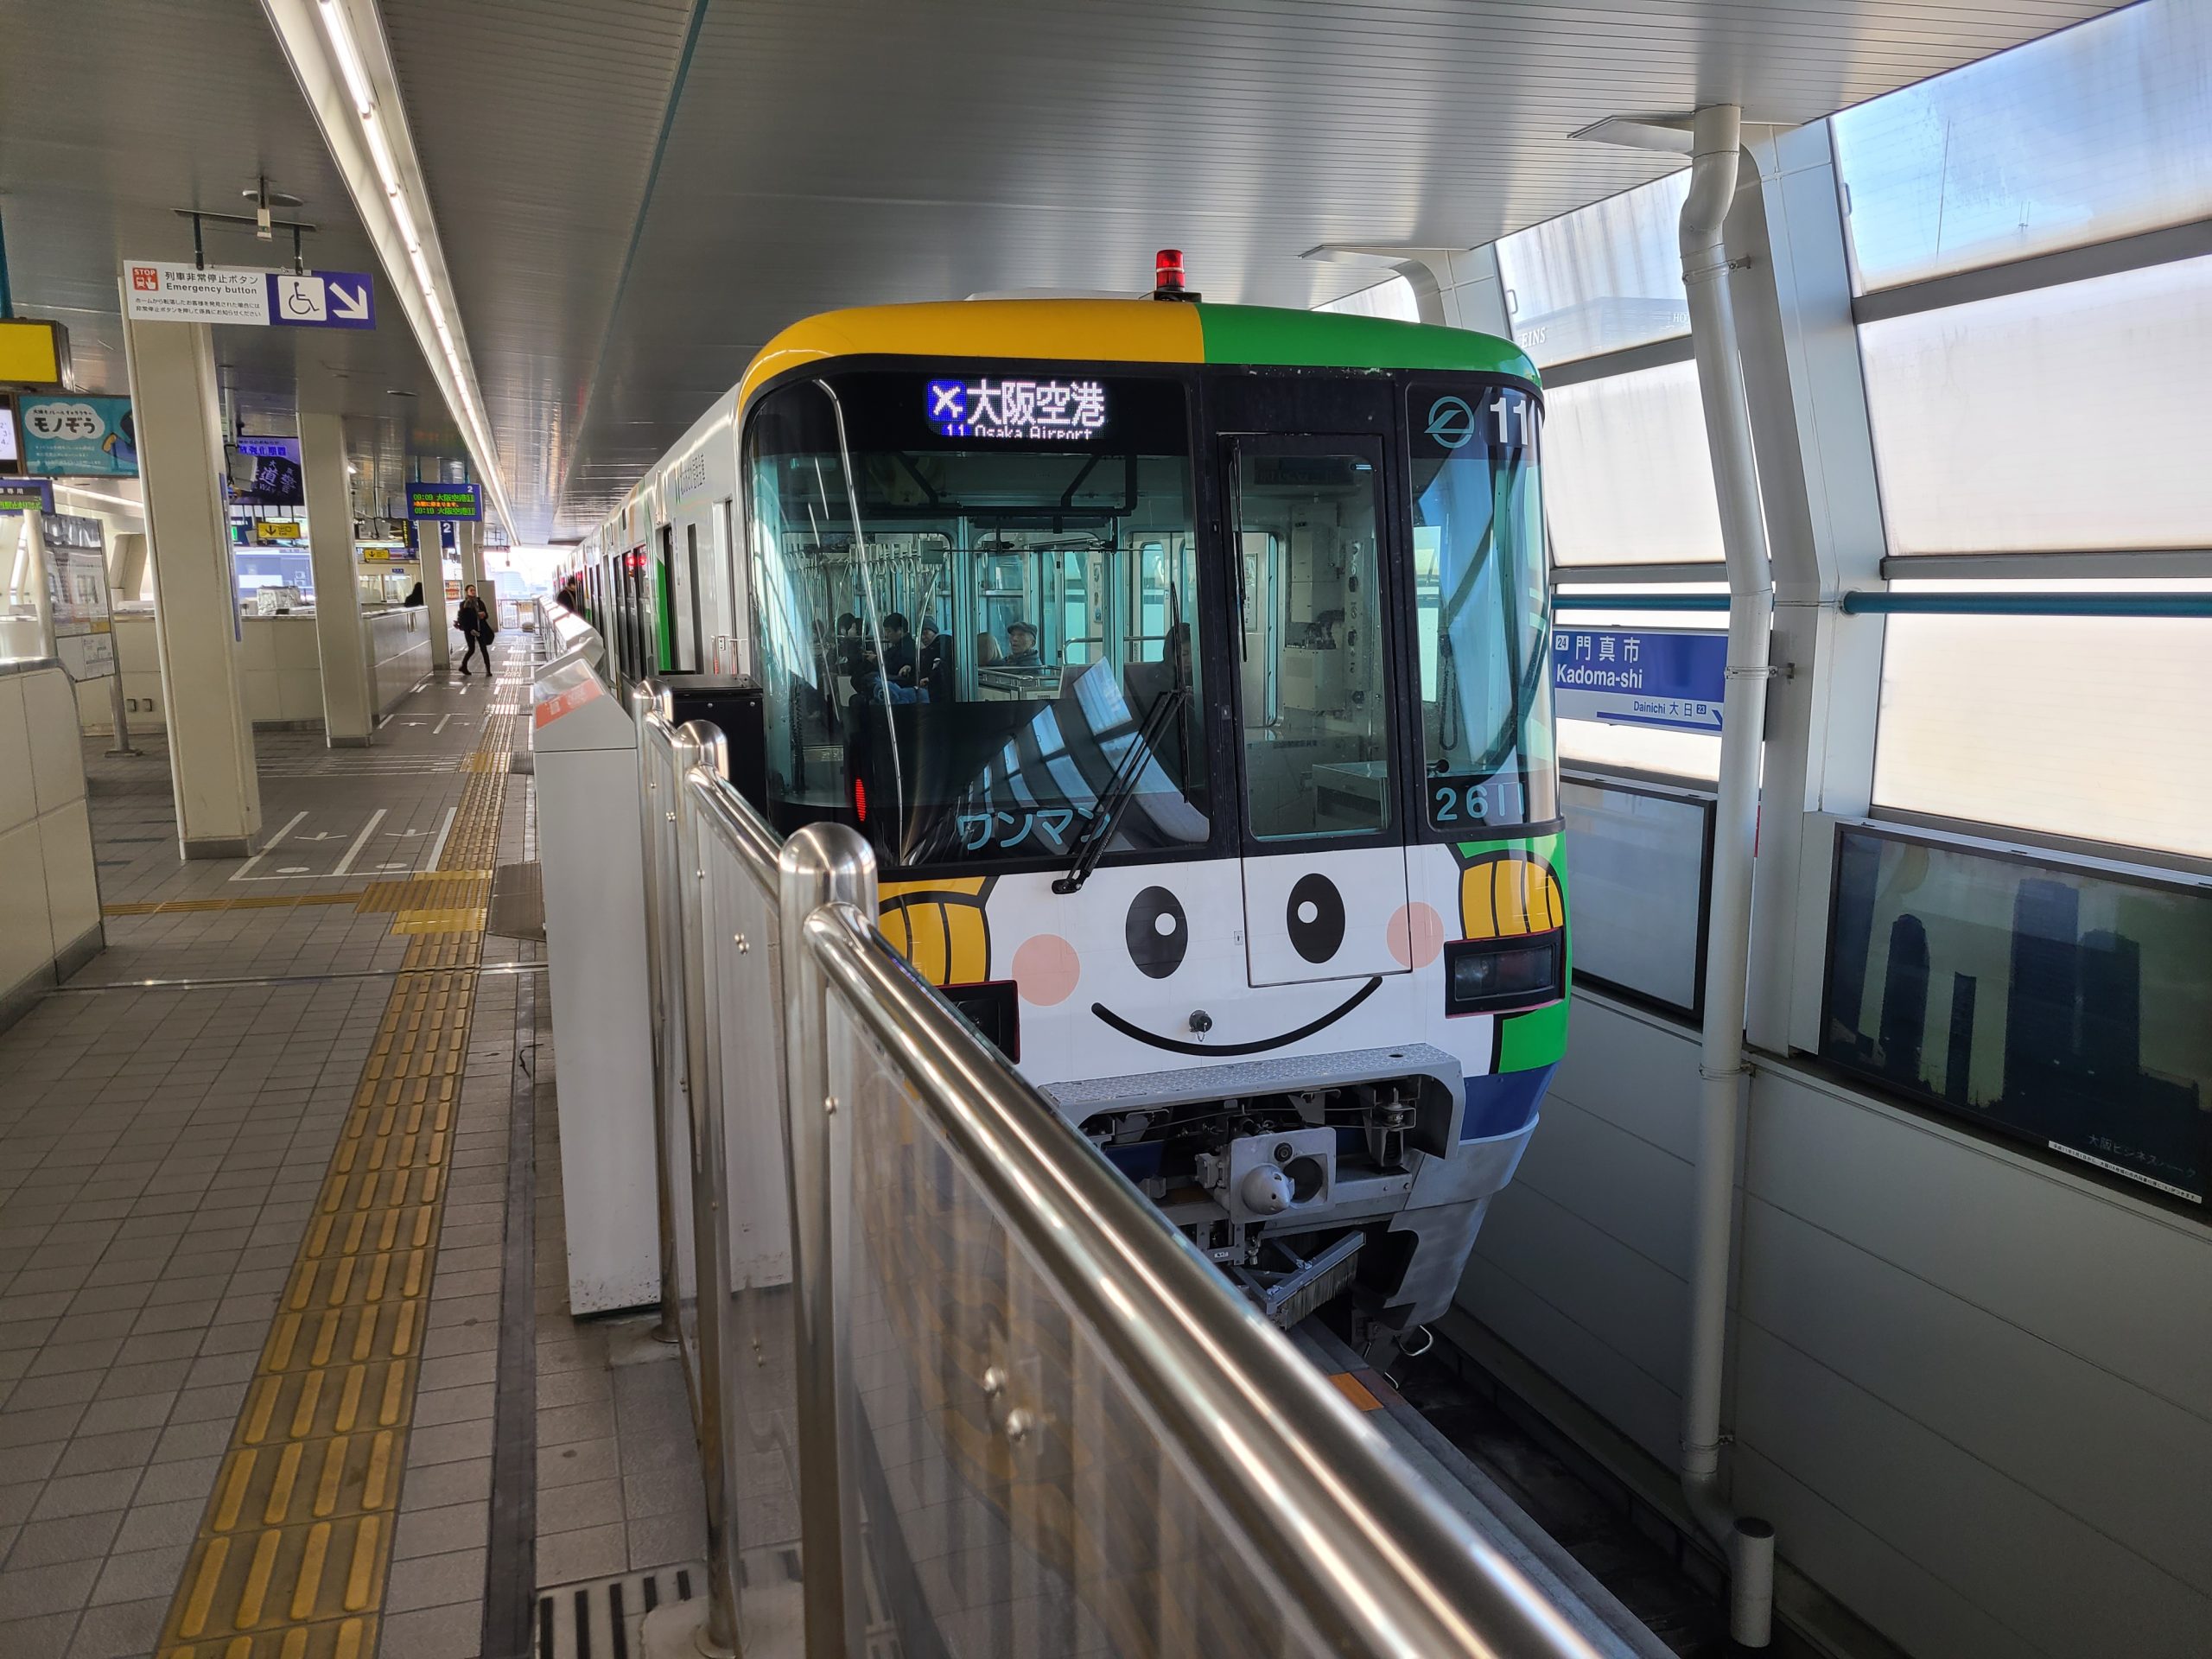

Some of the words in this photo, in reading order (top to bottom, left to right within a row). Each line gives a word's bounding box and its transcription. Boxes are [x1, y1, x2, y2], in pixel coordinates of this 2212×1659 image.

[165, 270, 258, 284] 列車非常停止ボタン
[166, 283, 221, 294] Emergency
[225, 286, 257, 295] button
[966, 378, 1105, 427] 大阪空港
[34, 416, 96, 434] モノぞう
[1490, 397, 1529, 446] 11
[947, 423, 964, 436] 11
[974, 424, 1022, 438] Osaka
[1029, 425, 1092, 439] Airport
[442, 522, 452, 533] 2
[1557, 636, 1567, 649] 24
[1575, 635, 1641, 664] 門真市
[1556, 663, 1643, 690] Kadoma-shi
[1633, 701, 1666, 715] Dainichi
[1669, 702, 1693, 717] 大日
[1697, 705, 1706, 714] 23
[1435, 782, 1525, 821] 2611
[957, 807, 1111, 851] ワンマン
